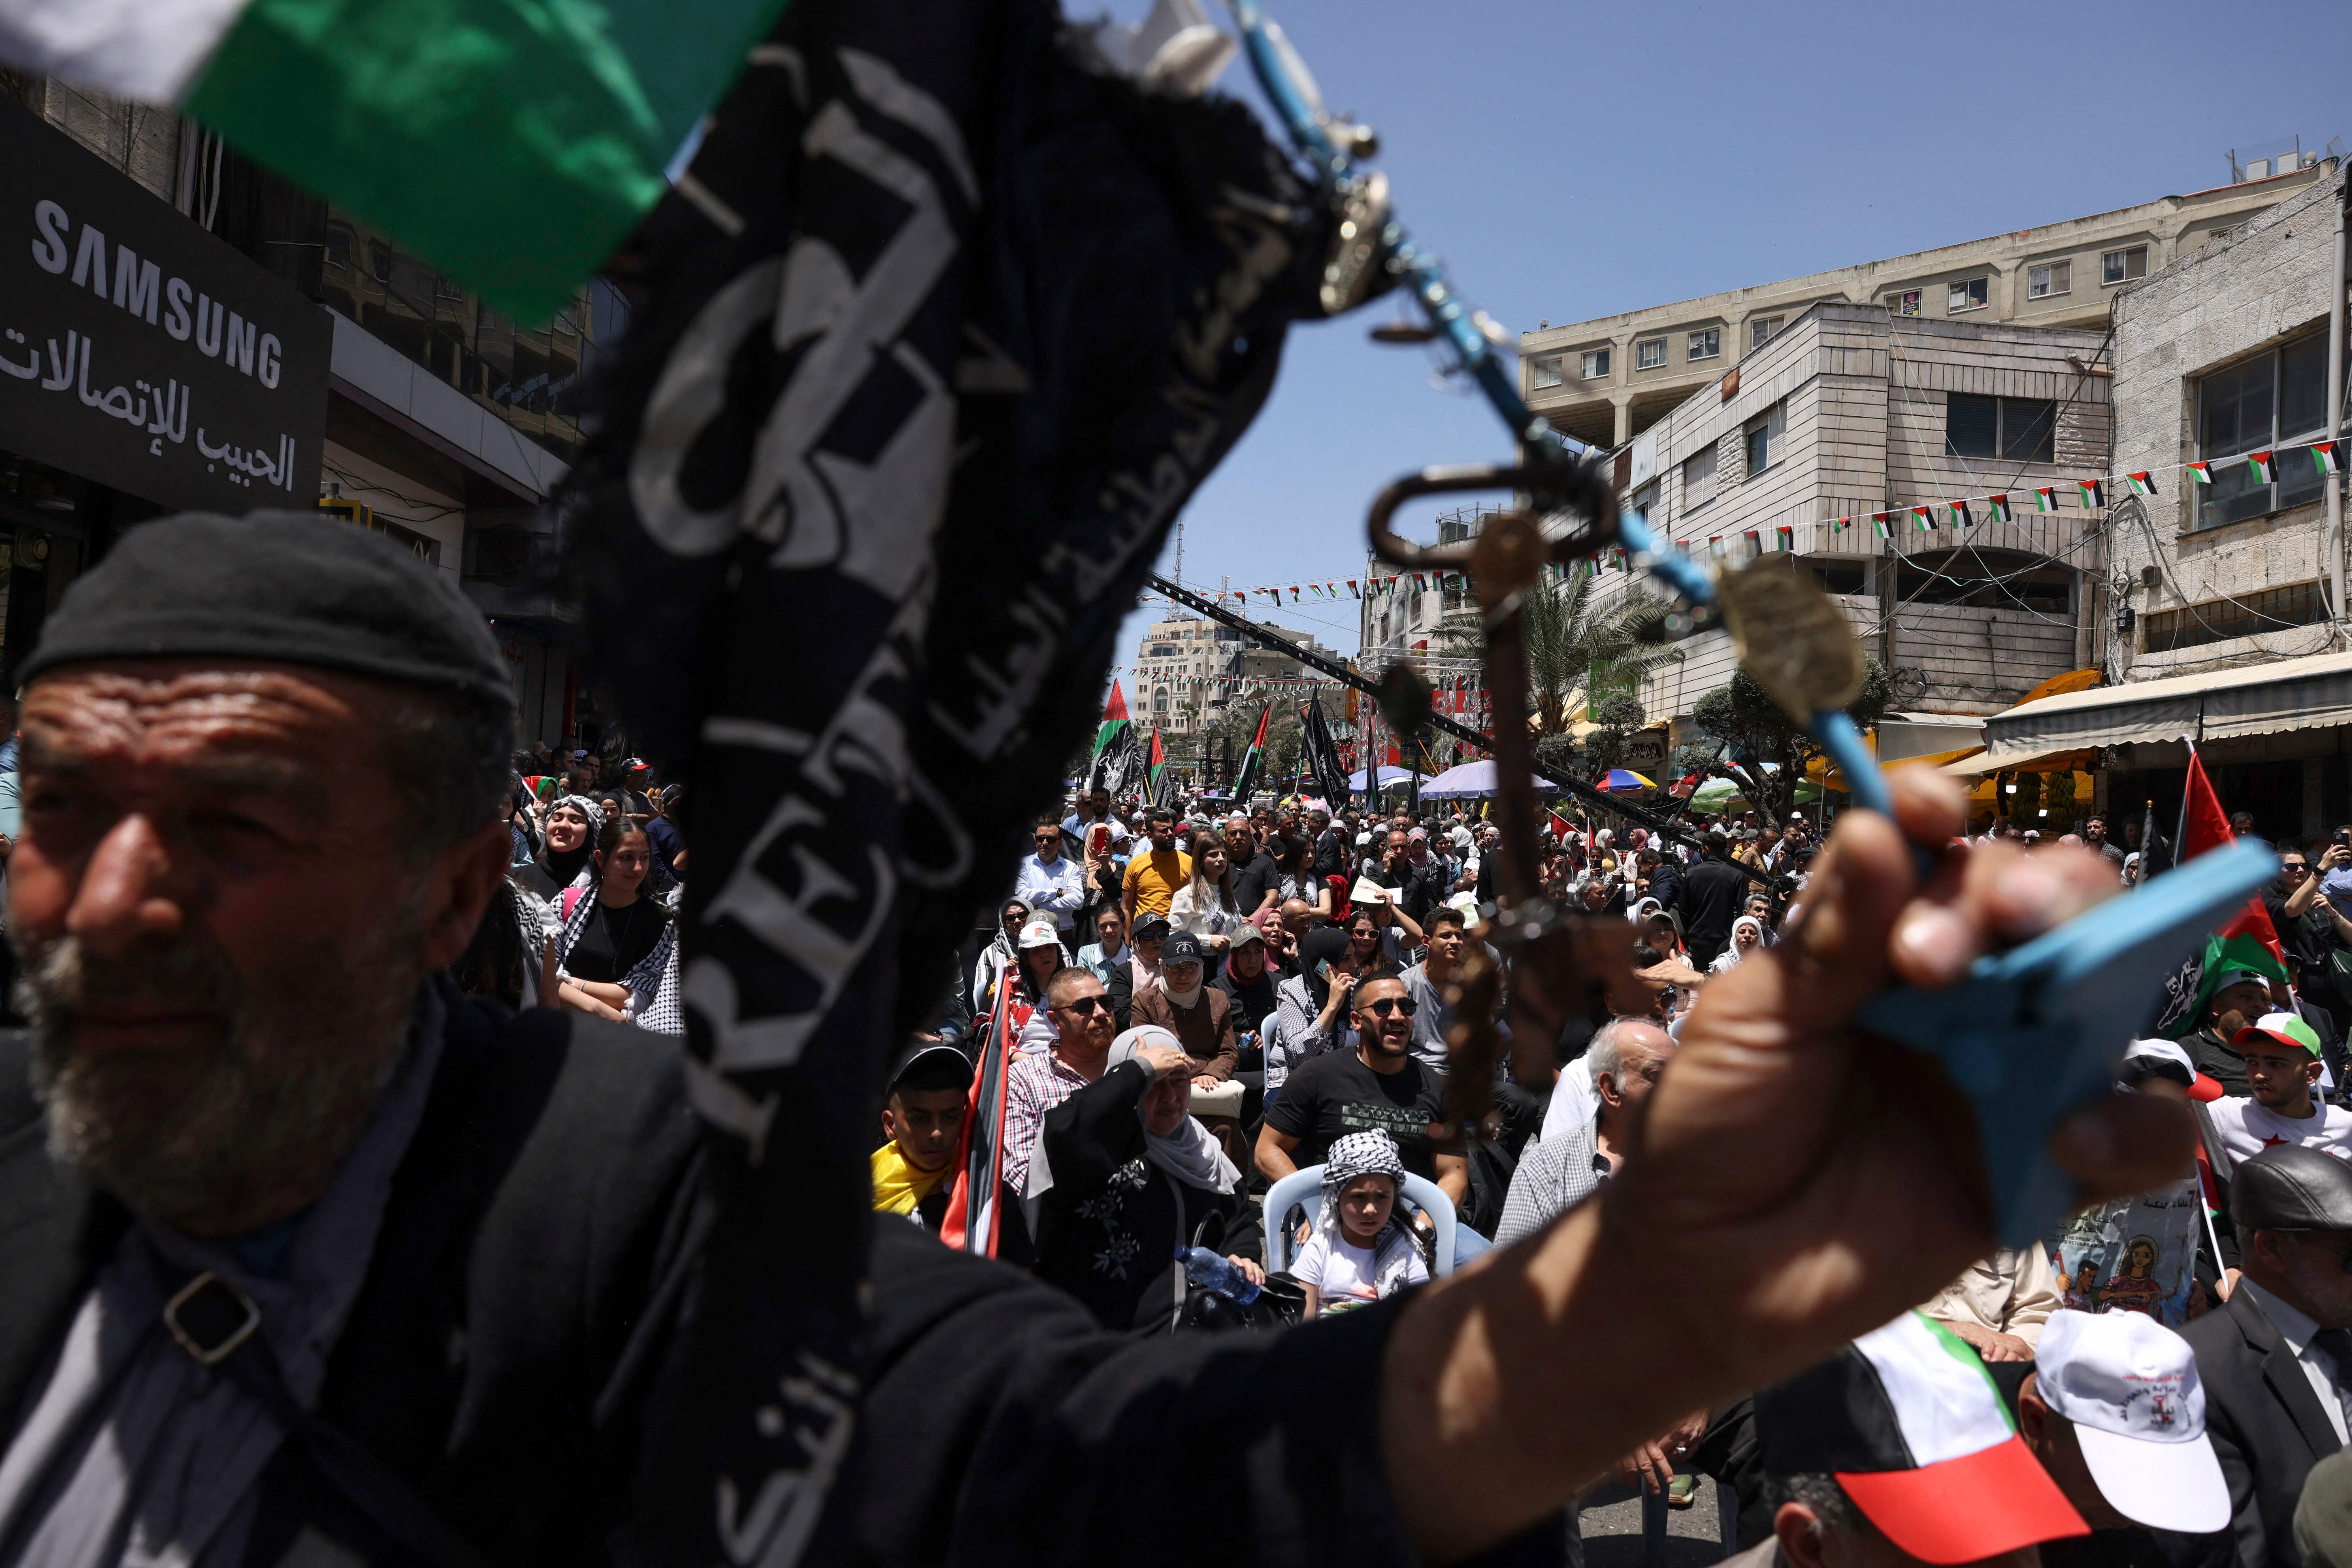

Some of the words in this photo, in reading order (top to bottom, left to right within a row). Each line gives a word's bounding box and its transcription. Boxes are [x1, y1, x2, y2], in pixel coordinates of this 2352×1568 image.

[32, 199, 282, 390] SAMSUNG
[197, 433, 295, 491] الحبيب
[1349, 1102, 1429, 1122] ATTITUDE
